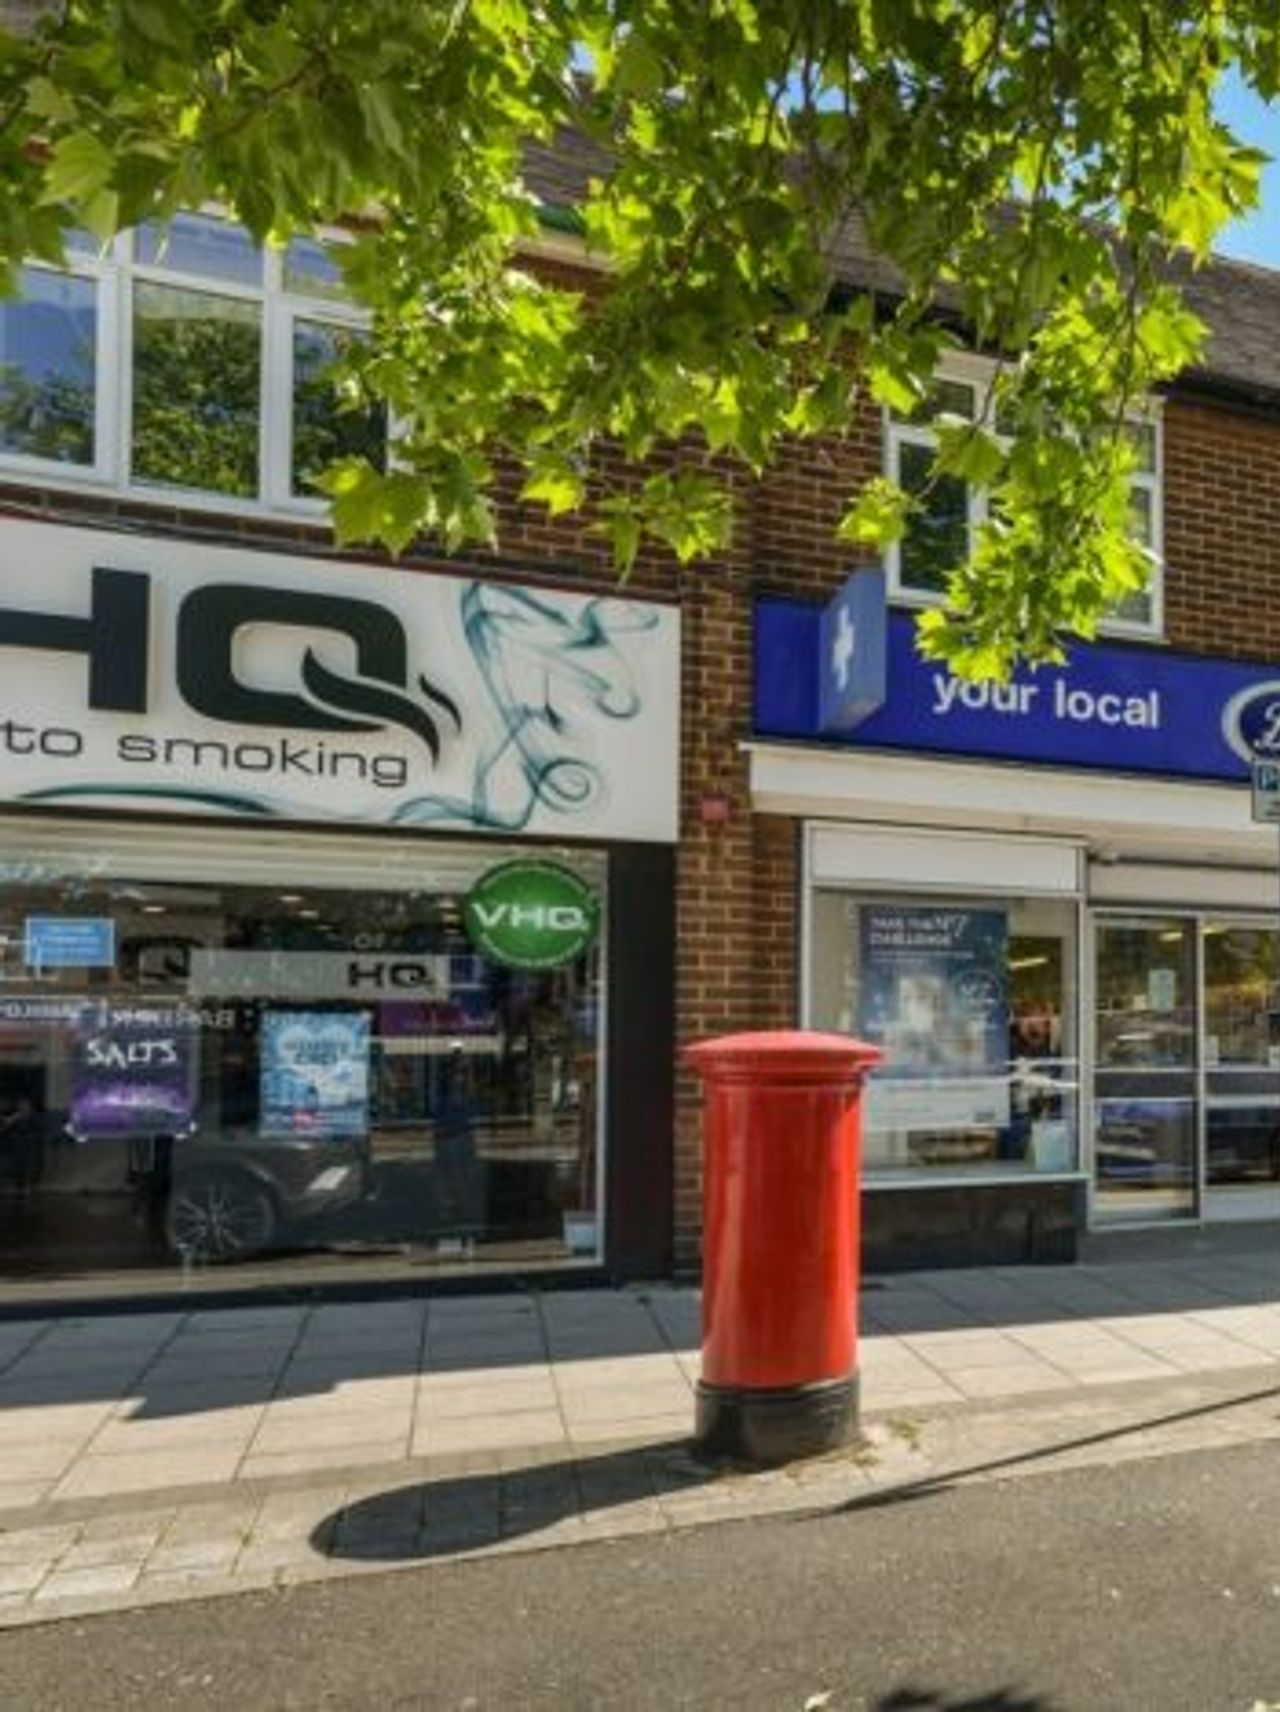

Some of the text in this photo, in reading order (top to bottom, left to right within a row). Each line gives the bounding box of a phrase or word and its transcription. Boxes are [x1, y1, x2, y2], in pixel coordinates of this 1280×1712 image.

[932, 672, 1160, 729] your local
[1, 718, 409, 788] to smoking
[470, 902, 589, 932] VHQ
[348, 961, 432, 988] HQ
[86, 1037, 178, 1069] SALTS
